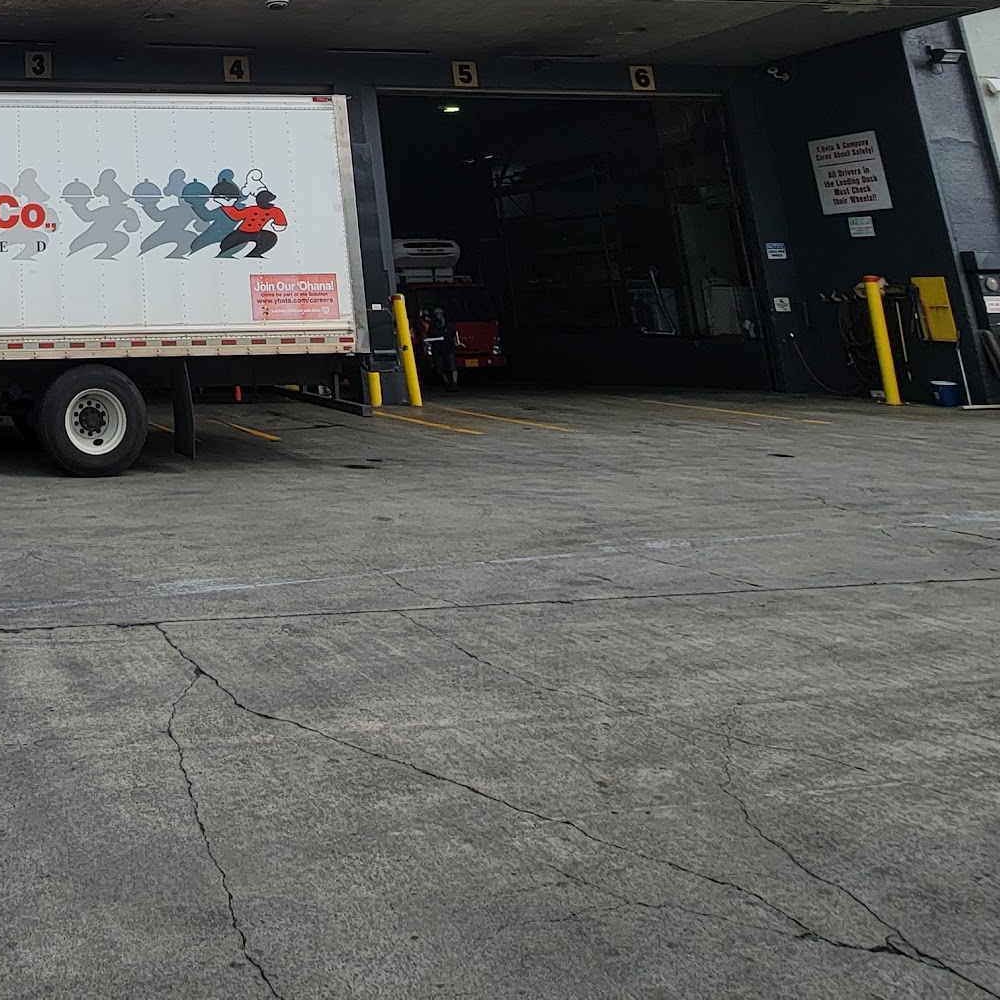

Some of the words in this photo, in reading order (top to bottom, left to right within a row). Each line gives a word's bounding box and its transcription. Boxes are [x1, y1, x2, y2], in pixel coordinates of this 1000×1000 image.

[32, 54, 45, 75] 3
[229, 59, 244, 79] 4
[458, 64, 473, 83] 5
[635, 68, 650, 87] 6
[842, 139, 869, 149] Company
[816, 153, 832, 161] Cares
[833, 150, 851, 159] About
[828, 170, 837, 179] All
[838, 168, 861, 177] Drivers
[862, 166, 870, 174] in
[824, 180, 834, 188] the
[836, 177, 860, 187] Loading
[862, 175, 878, 183] Dock
[834, 187, 850, 196] Must
[833, 197, 848, 206] their
[253, 281, 275, 291] Join
[276, 281, 296, 291] Our
